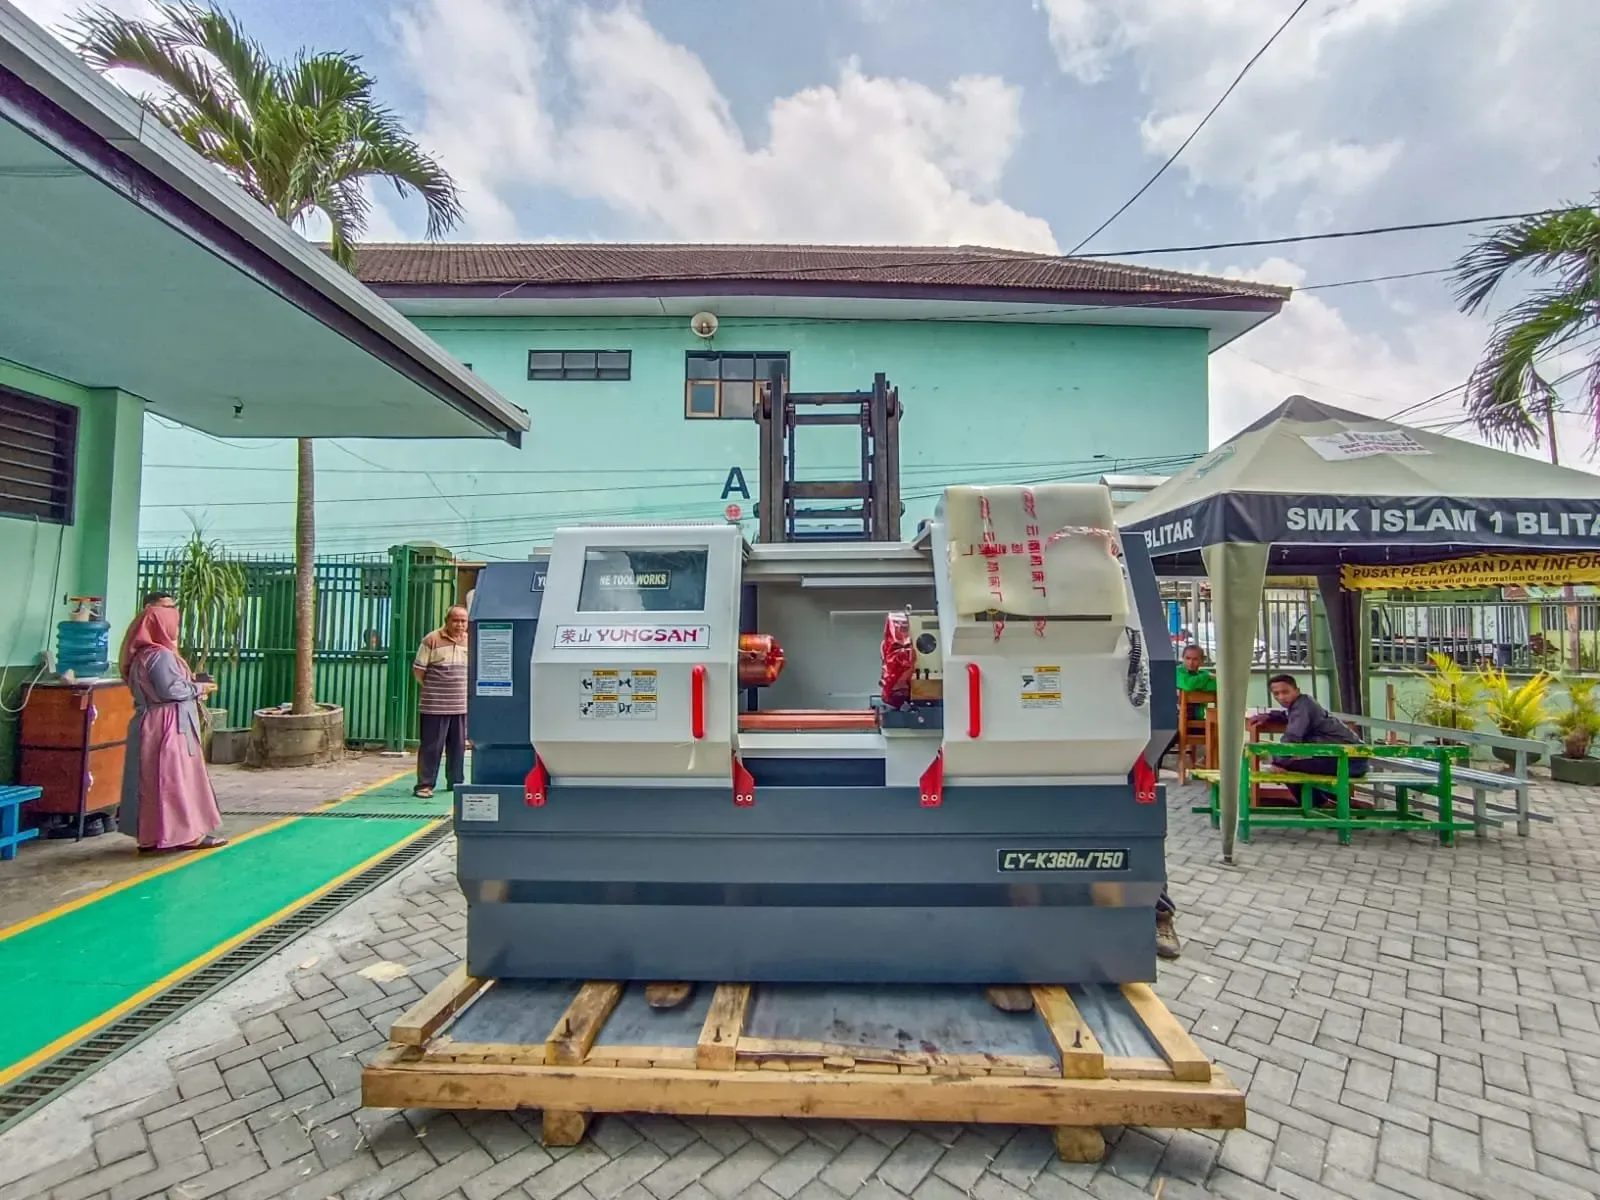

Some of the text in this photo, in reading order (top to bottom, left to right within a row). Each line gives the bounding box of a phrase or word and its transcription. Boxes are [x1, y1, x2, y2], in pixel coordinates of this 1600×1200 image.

[720, 466, 750, 500] A
[1144, 518, 1195, 548] BLITAR
[1286, 508, 1361, 532] SMK
[1371, 509, 1477, 532] ISLAM
[1489, 511, 1503, 534] 1
[613, 574, 634, 585] TOOL
[635, 574, 667, 585] WORKS
[1353, 567, 1399, 579] PUSAT
[1401, 560, 1495, 578] PELAYANAN
[1499, 559, 1538, 572] DAN
